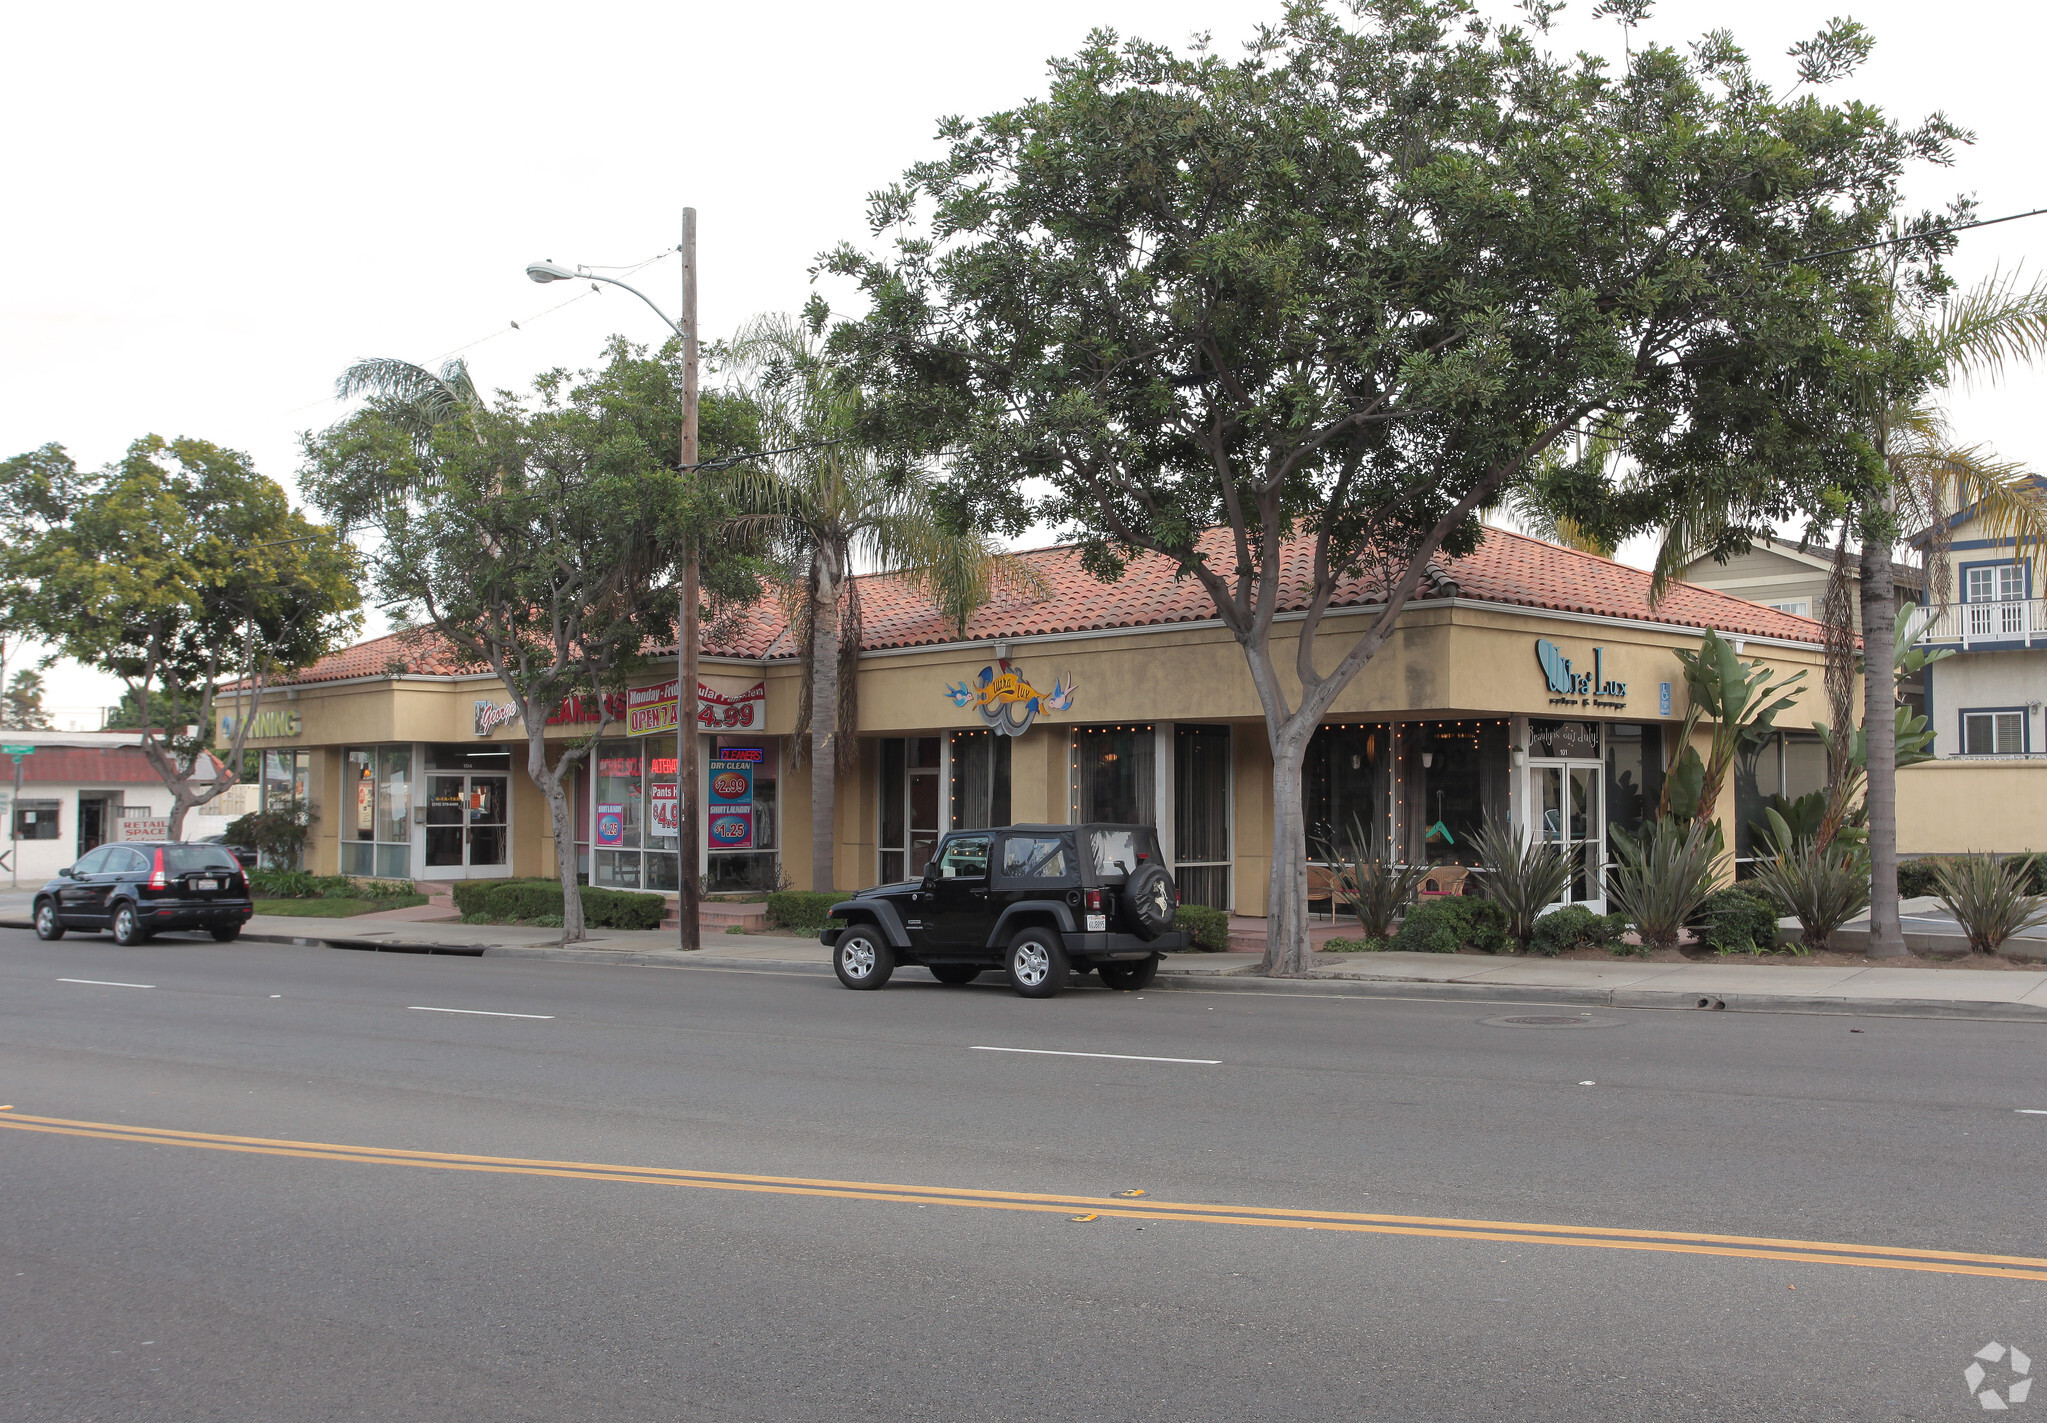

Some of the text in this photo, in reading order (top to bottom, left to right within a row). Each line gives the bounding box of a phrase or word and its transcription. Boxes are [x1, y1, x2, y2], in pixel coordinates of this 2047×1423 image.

[1540, 640, 1628, 696] Ultra Lux
[630, 688, 659, 705] Monday
[664, 682, 678, 698] Frid
[698, 687, 720, 700] ular
[482, 701, 518, 733] George
[631, 702, 678, 732] OPEN 7 A
[698, 704, 754, 727] 4.99
[234, 710, 300, 738] ANNING
[722, 748, 762, 760] CLEANERS
[710, 761, 751, 770] DRY CLEAN
[652, 786, 672, 797] Pants
[714, 778, 745, 793] $2.99
[652, 803, 678, 829] $4.9
[710, 805, 752, 814] SHIRT LAUNDRY
[601, 822, 618, 836] $1.25
[714, 823, 744, 838] $1.25
